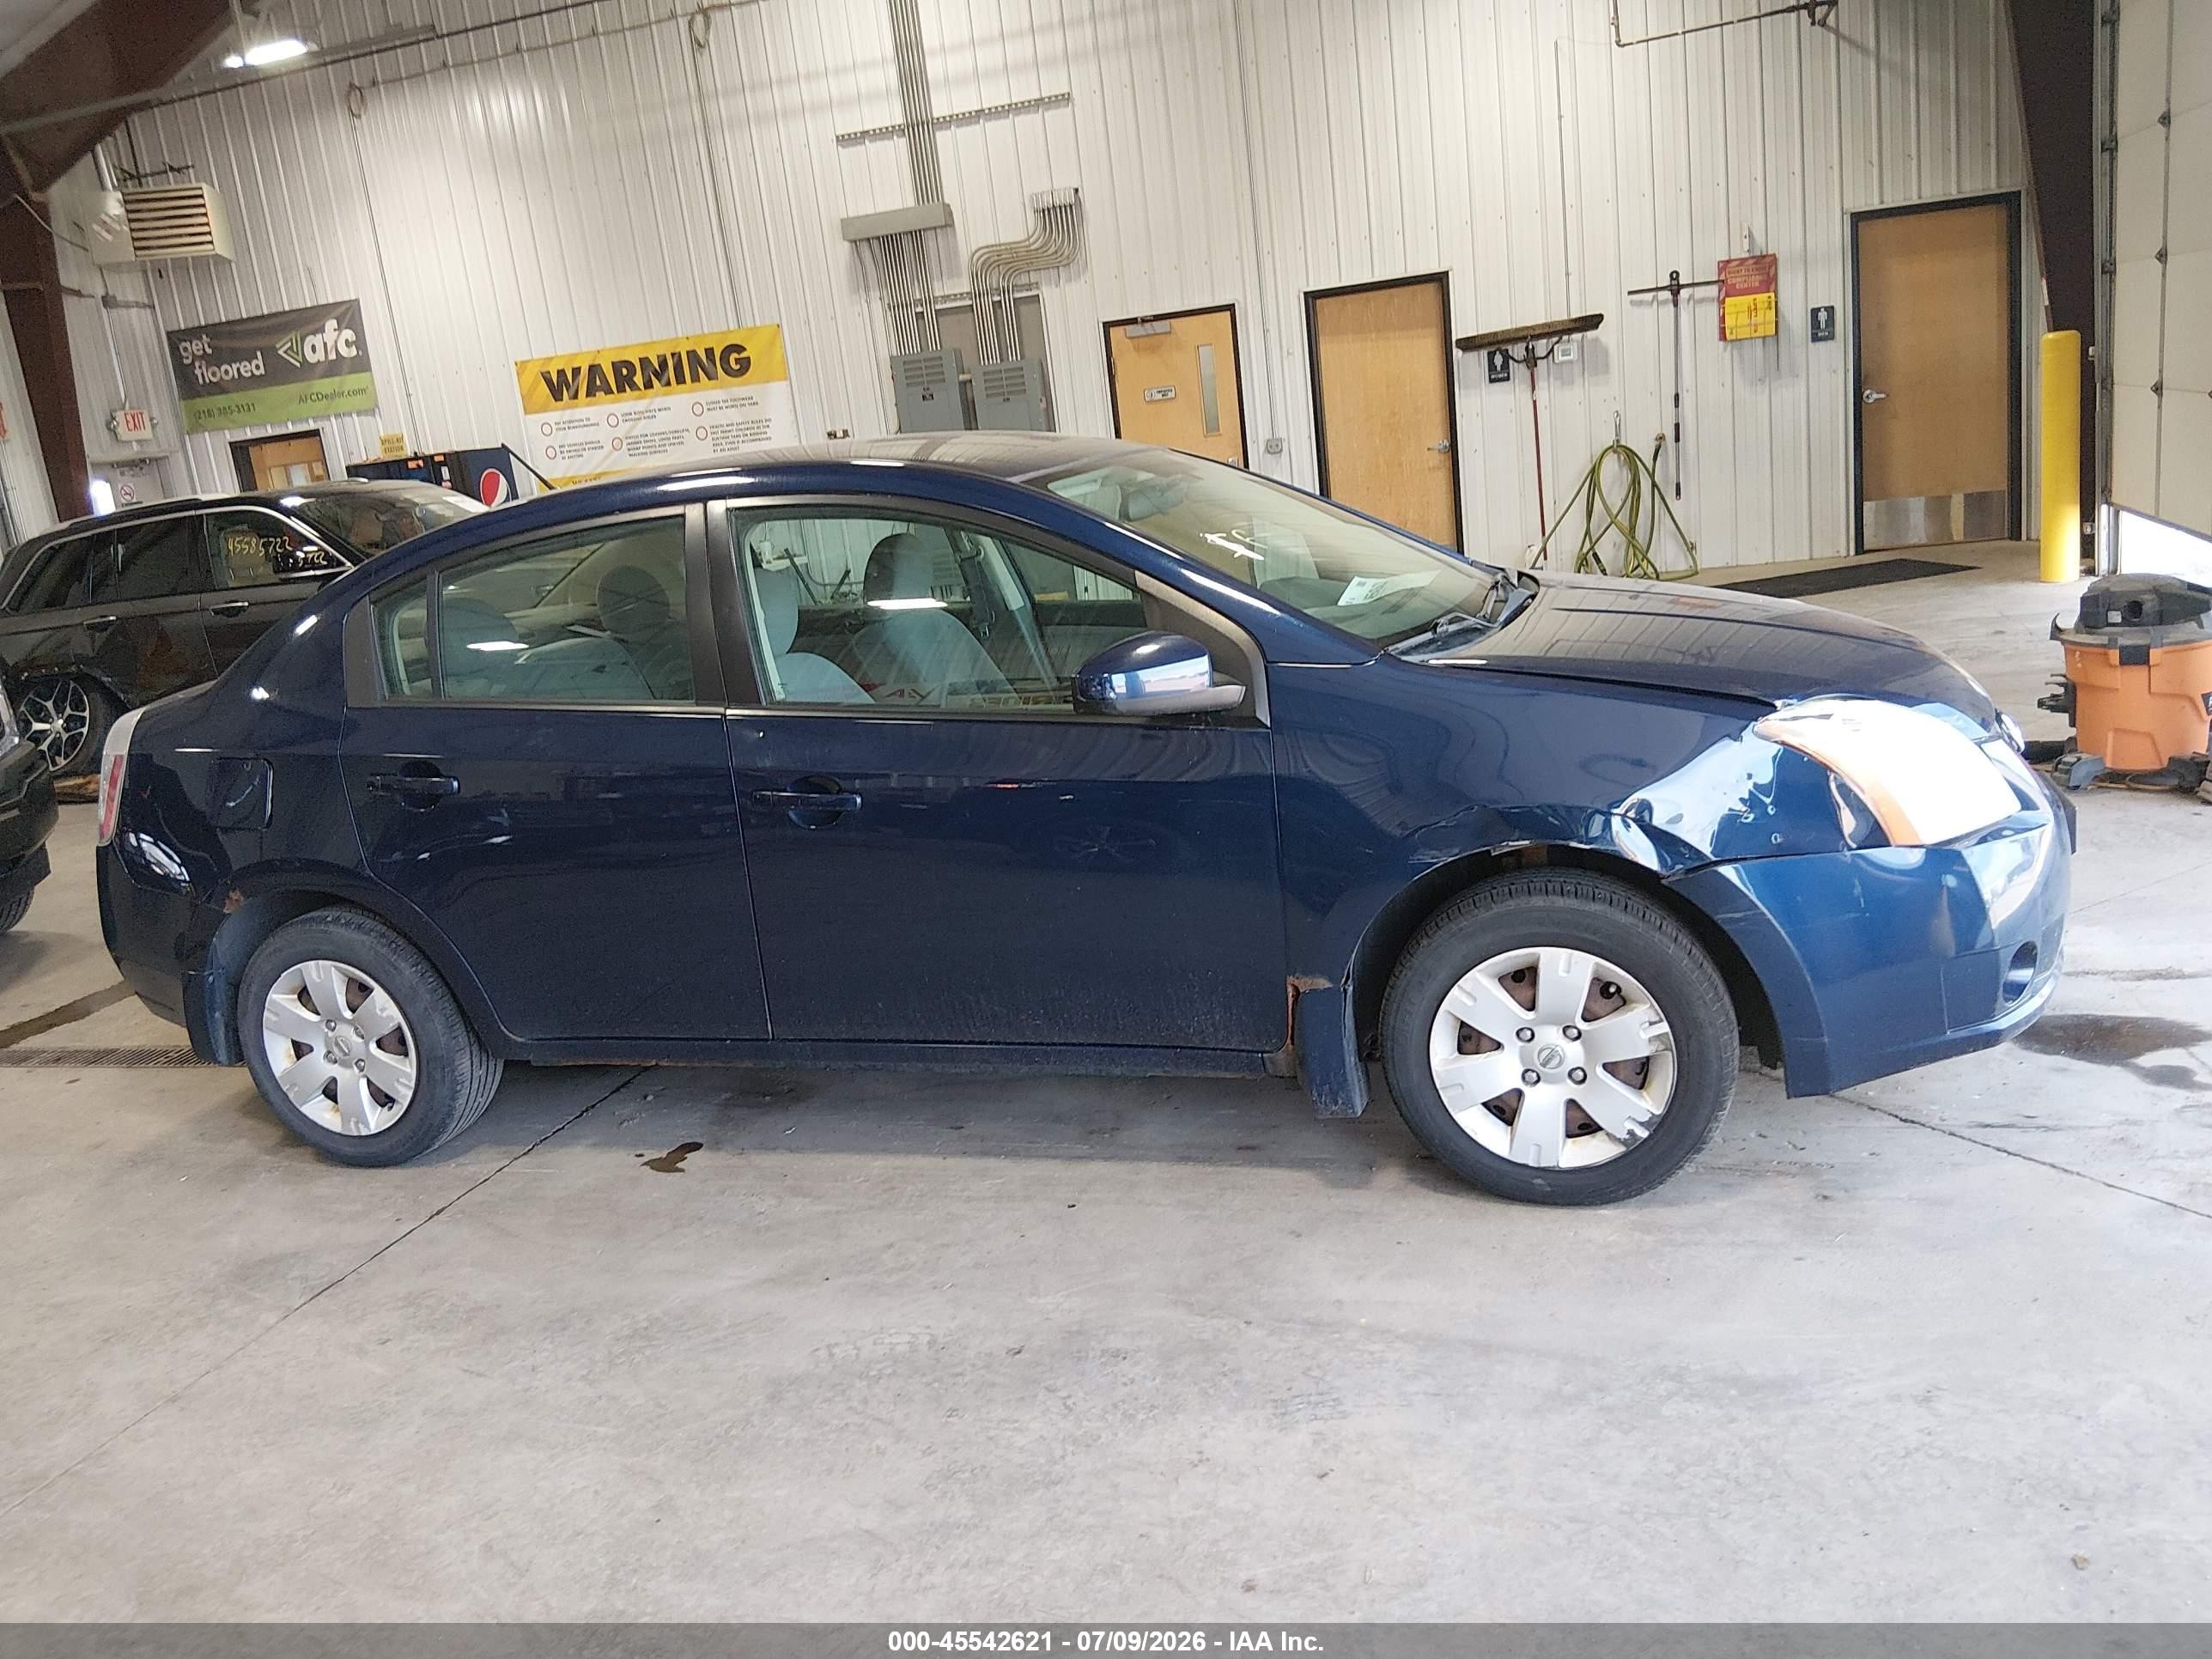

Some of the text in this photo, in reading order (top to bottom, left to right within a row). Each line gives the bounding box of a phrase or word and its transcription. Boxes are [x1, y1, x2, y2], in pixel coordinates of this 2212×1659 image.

[179, 334, 212, 365] get
[194, 350, 265, 385] floored
[540, 343, 751, 403] WARNING
[124, 411, 147, 432] EXIT
